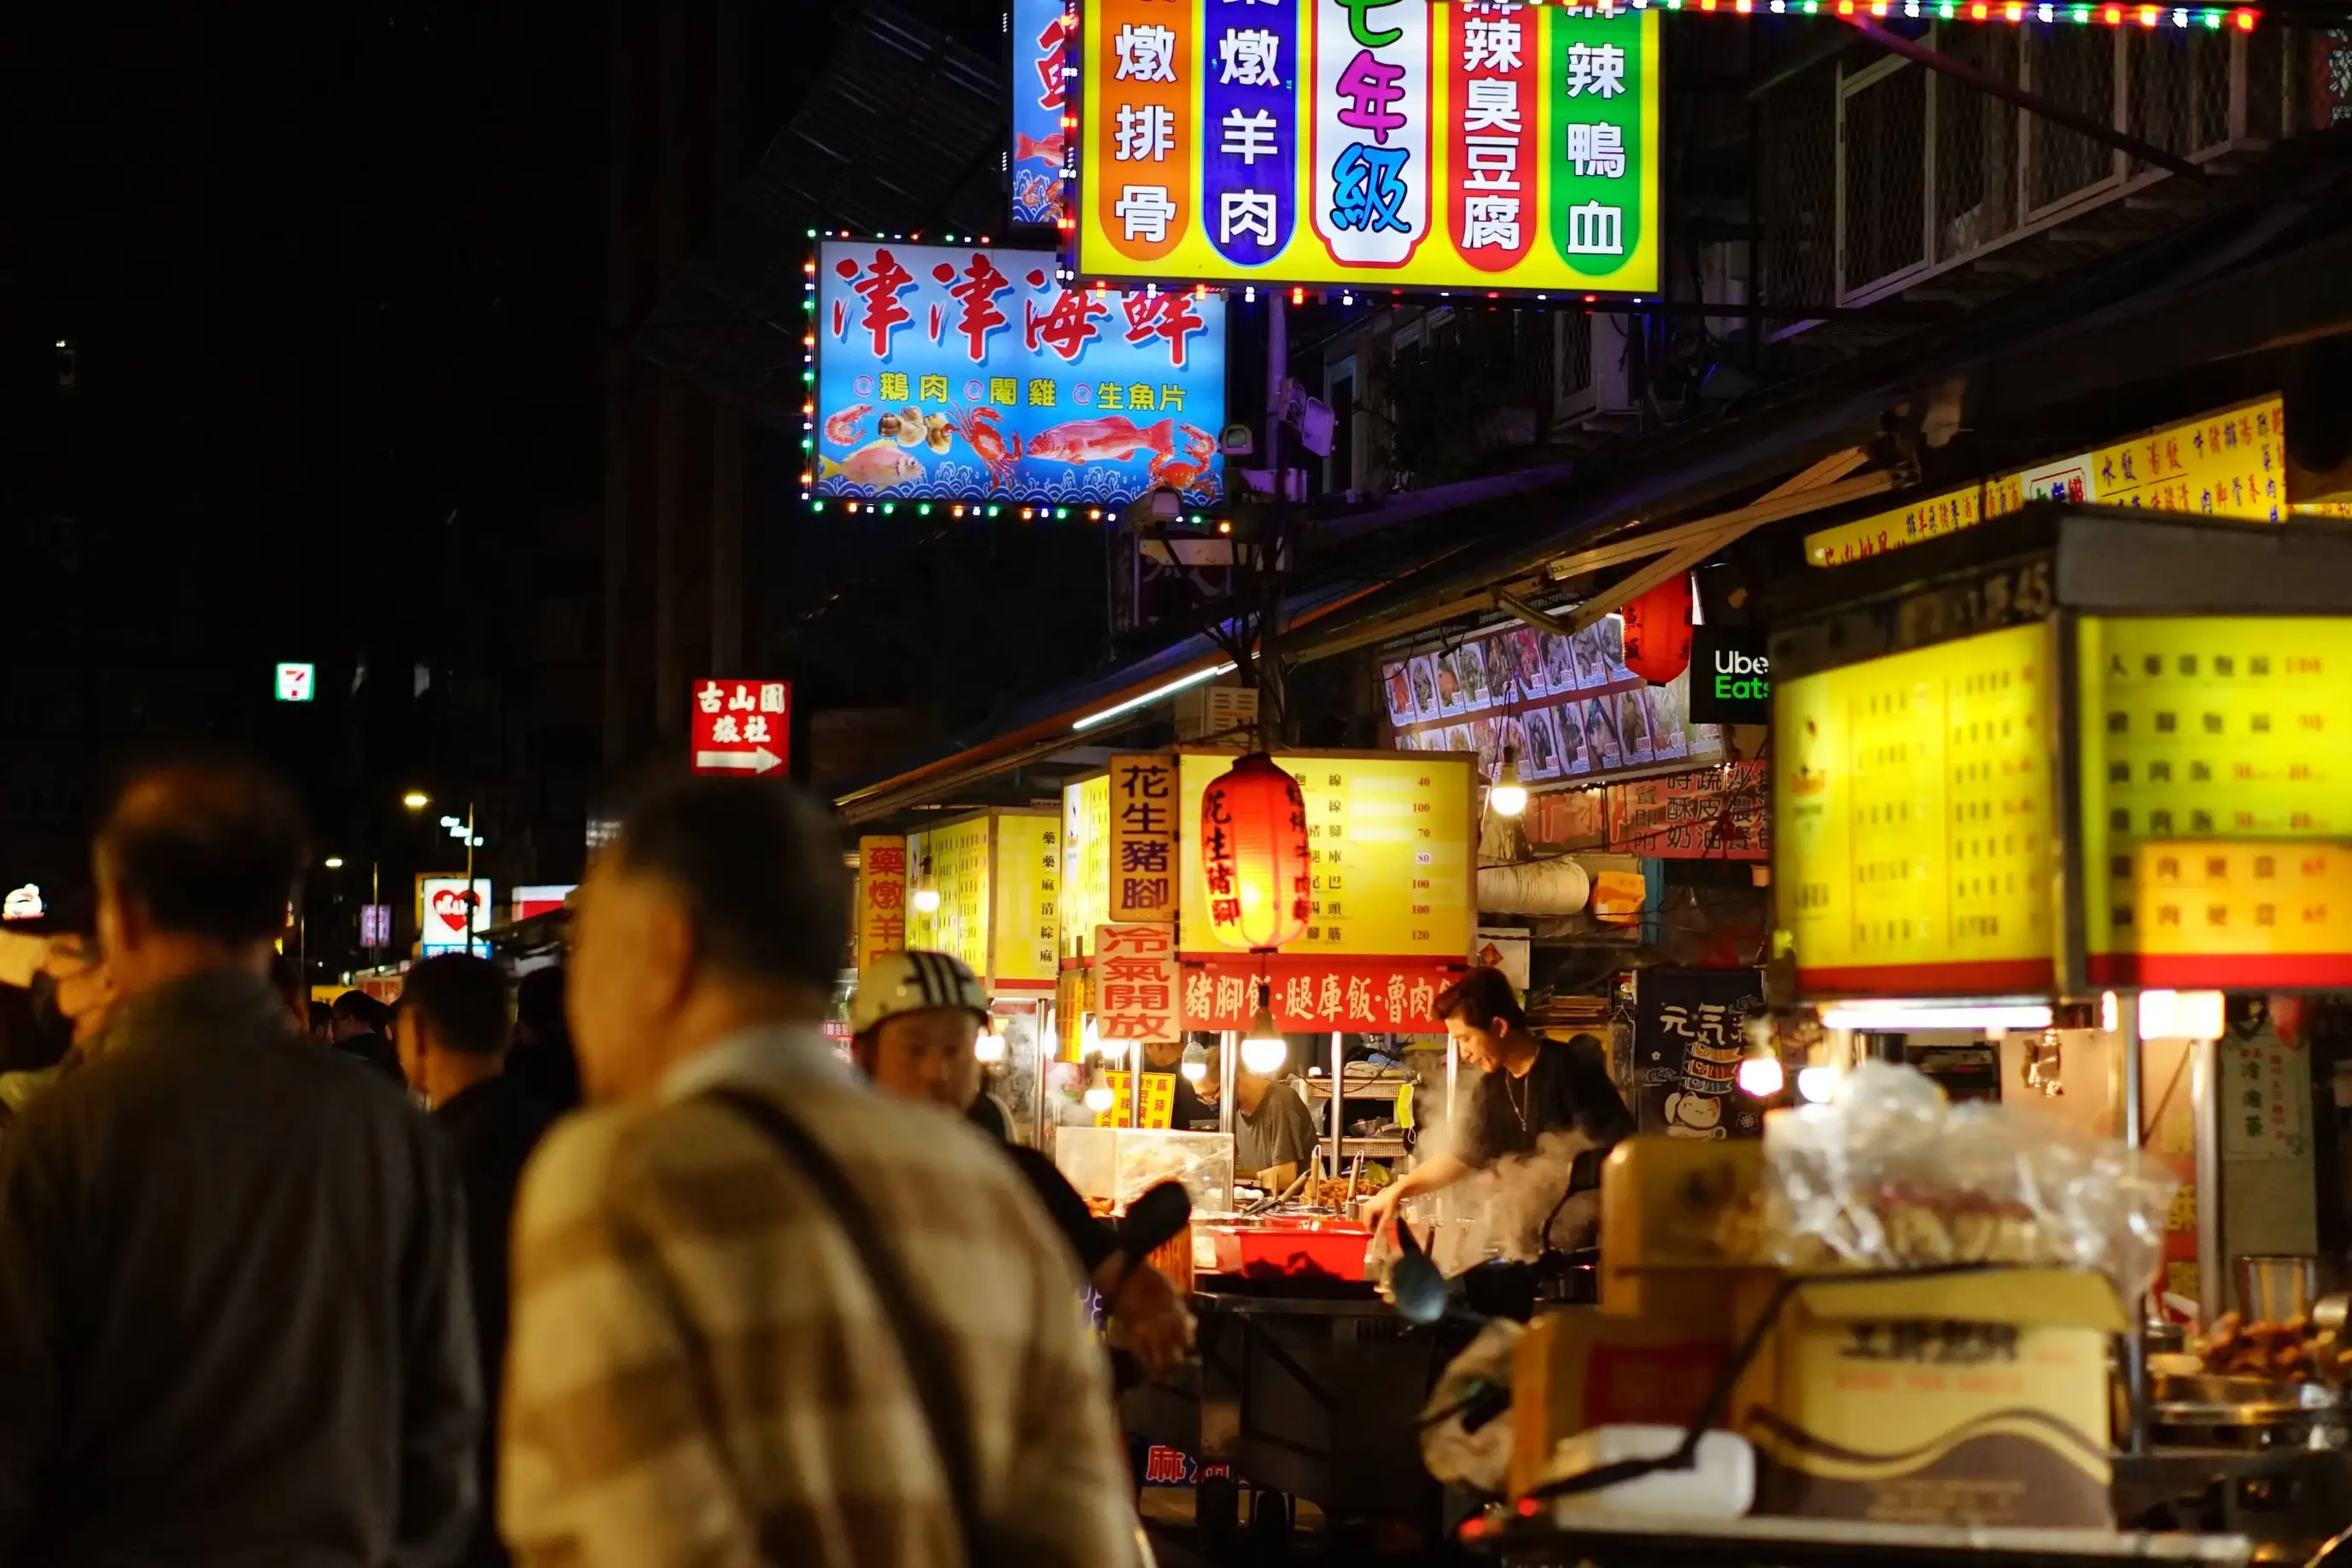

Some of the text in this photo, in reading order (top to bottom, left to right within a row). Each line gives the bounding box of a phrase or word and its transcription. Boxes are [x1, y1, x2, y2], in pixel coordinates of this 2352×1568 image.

[1114, 0, 1177, 242] 燉排骨
[1218, 0, 1281, 248] 燉羊肉
[1332, 0, 1412, 233] 七年級
[1462, 2, 1523, 252] 辣臭豆腐
[1566, 4, 1630, 257] 辣鴨血
[833, 248, 1206, 368] 津津海鮮
[878, 371, 949, 405] 鵝肉
[1096, 382, 1188, 413] 生魚片
[712, 714, 771, 743] 旅社
[1120, 765, 1170, 911] 花生豬腳
[1412, 802, 1431, 813] 100
[1417, 828, 1431, 838] 70
[1411, 879, 1430, 889] 100
[1411, 905, 1430, 915] 100
[1411, 930, 1430, 941] 120
[1102, 927, 1171, 1040] 冷氣開放
